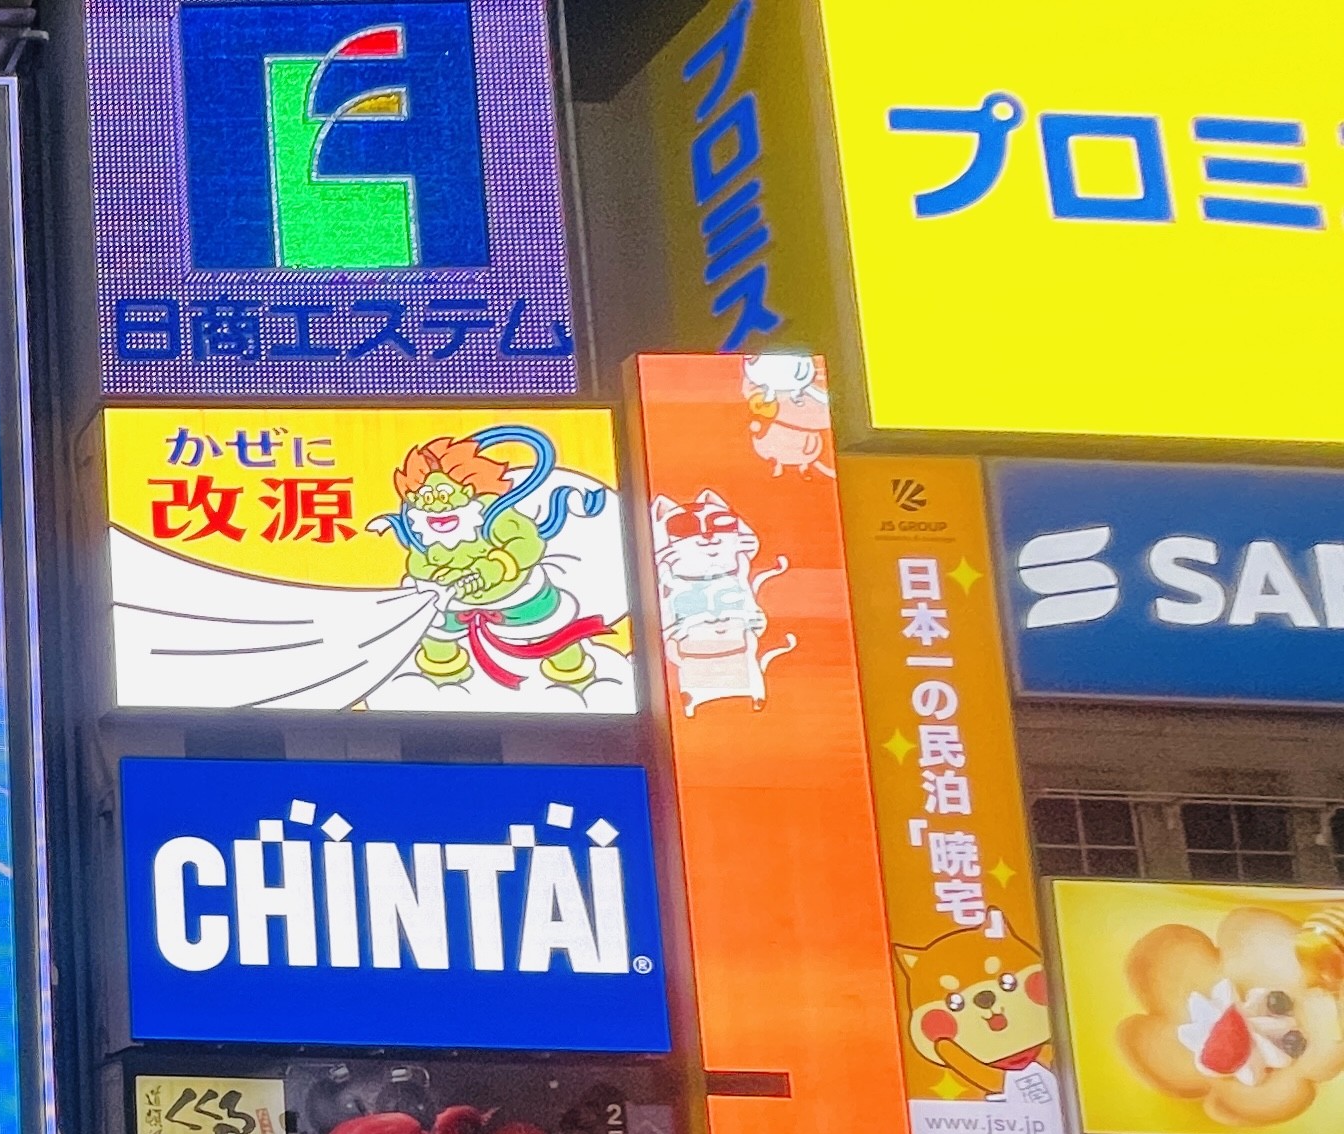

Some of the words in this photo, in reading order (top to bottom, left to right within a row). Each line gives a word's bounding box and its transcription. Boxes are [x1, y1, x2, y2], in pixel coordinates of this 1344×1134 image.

[887, 91, 1344, 231] プロミ
[114, 298, 573, 362] 日商エステム
[165, 426, 337, 468] かぜに
[147, 475, 358, 544] 改源
[153, 799, 632, 974] CHINTAI
